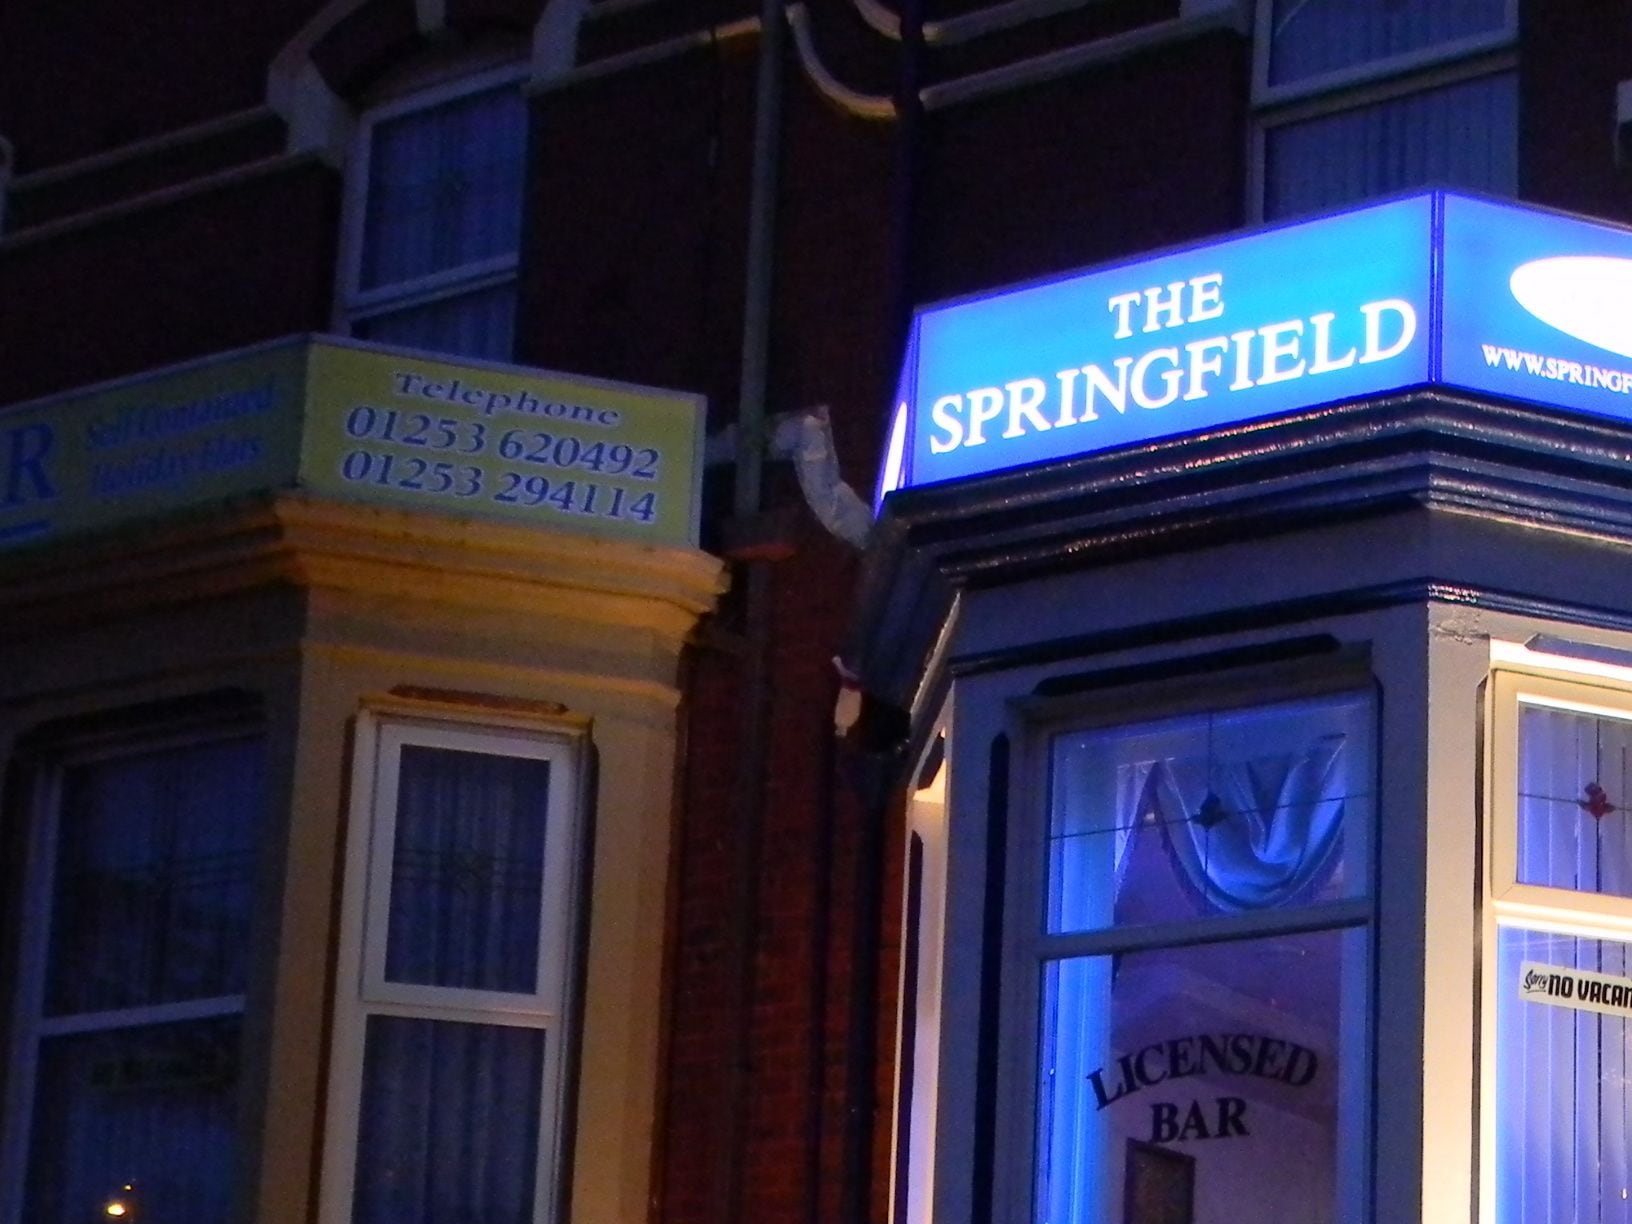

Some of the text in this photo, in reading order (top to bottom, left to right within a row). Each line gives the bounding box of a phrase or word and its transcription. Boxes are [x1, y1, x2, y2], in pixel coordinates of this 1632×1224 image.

[1109, 273, 1225, 339] THE
[398, 373, 619, 425] Telephone
[929, 299, 1416, 455] SPRINGFIELD
[347, 406, 658, 479] 01253 620492
[343, 451, 655, 521] 01253 294114
[1548, 974, 1573, 998] NO
[1086, 1033, 1319, 1111] LICENSED
[1151, 1097, 1250, 1143] BAR
